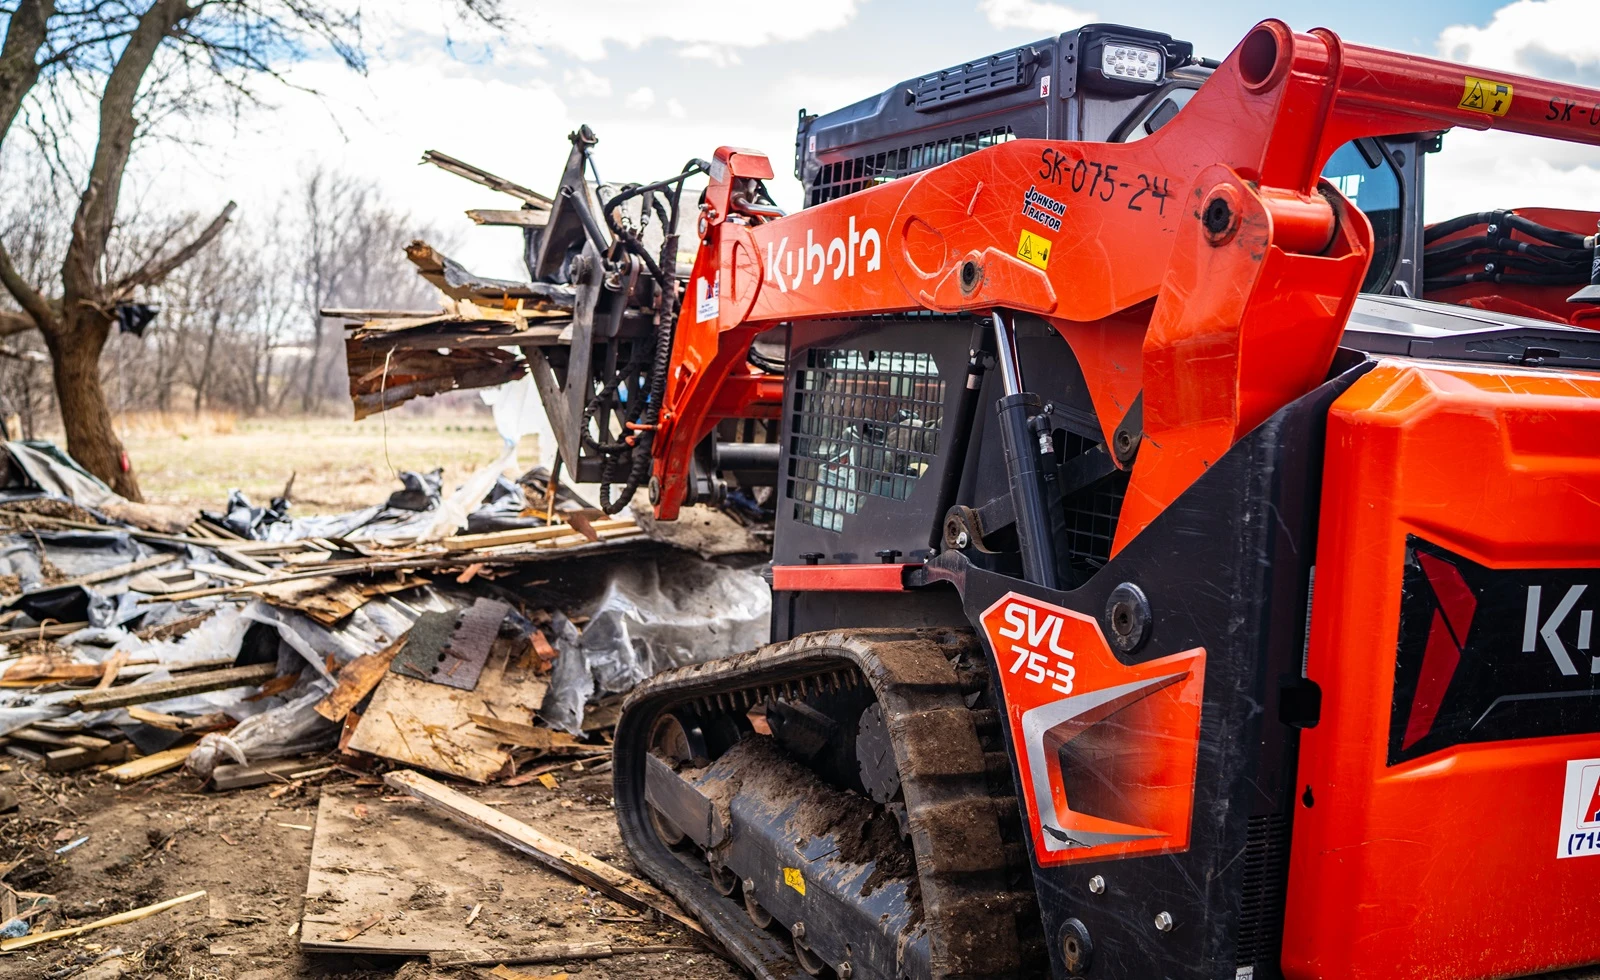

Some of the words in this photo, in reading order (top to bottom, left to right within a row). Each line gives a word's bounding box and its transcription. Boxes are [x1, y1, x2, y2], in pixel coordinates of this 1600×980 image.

[1025, 186, 1066, 216] JOHNSON
[1039, 148, 1169, 215] SK-075-24
[1022, 199, 1061, 231] TRACTOR
[767, 216, 880, 293] Kubota
[999, 602, 1074, 660] SVL
[1009, 645, 1076, 694] 75-3
